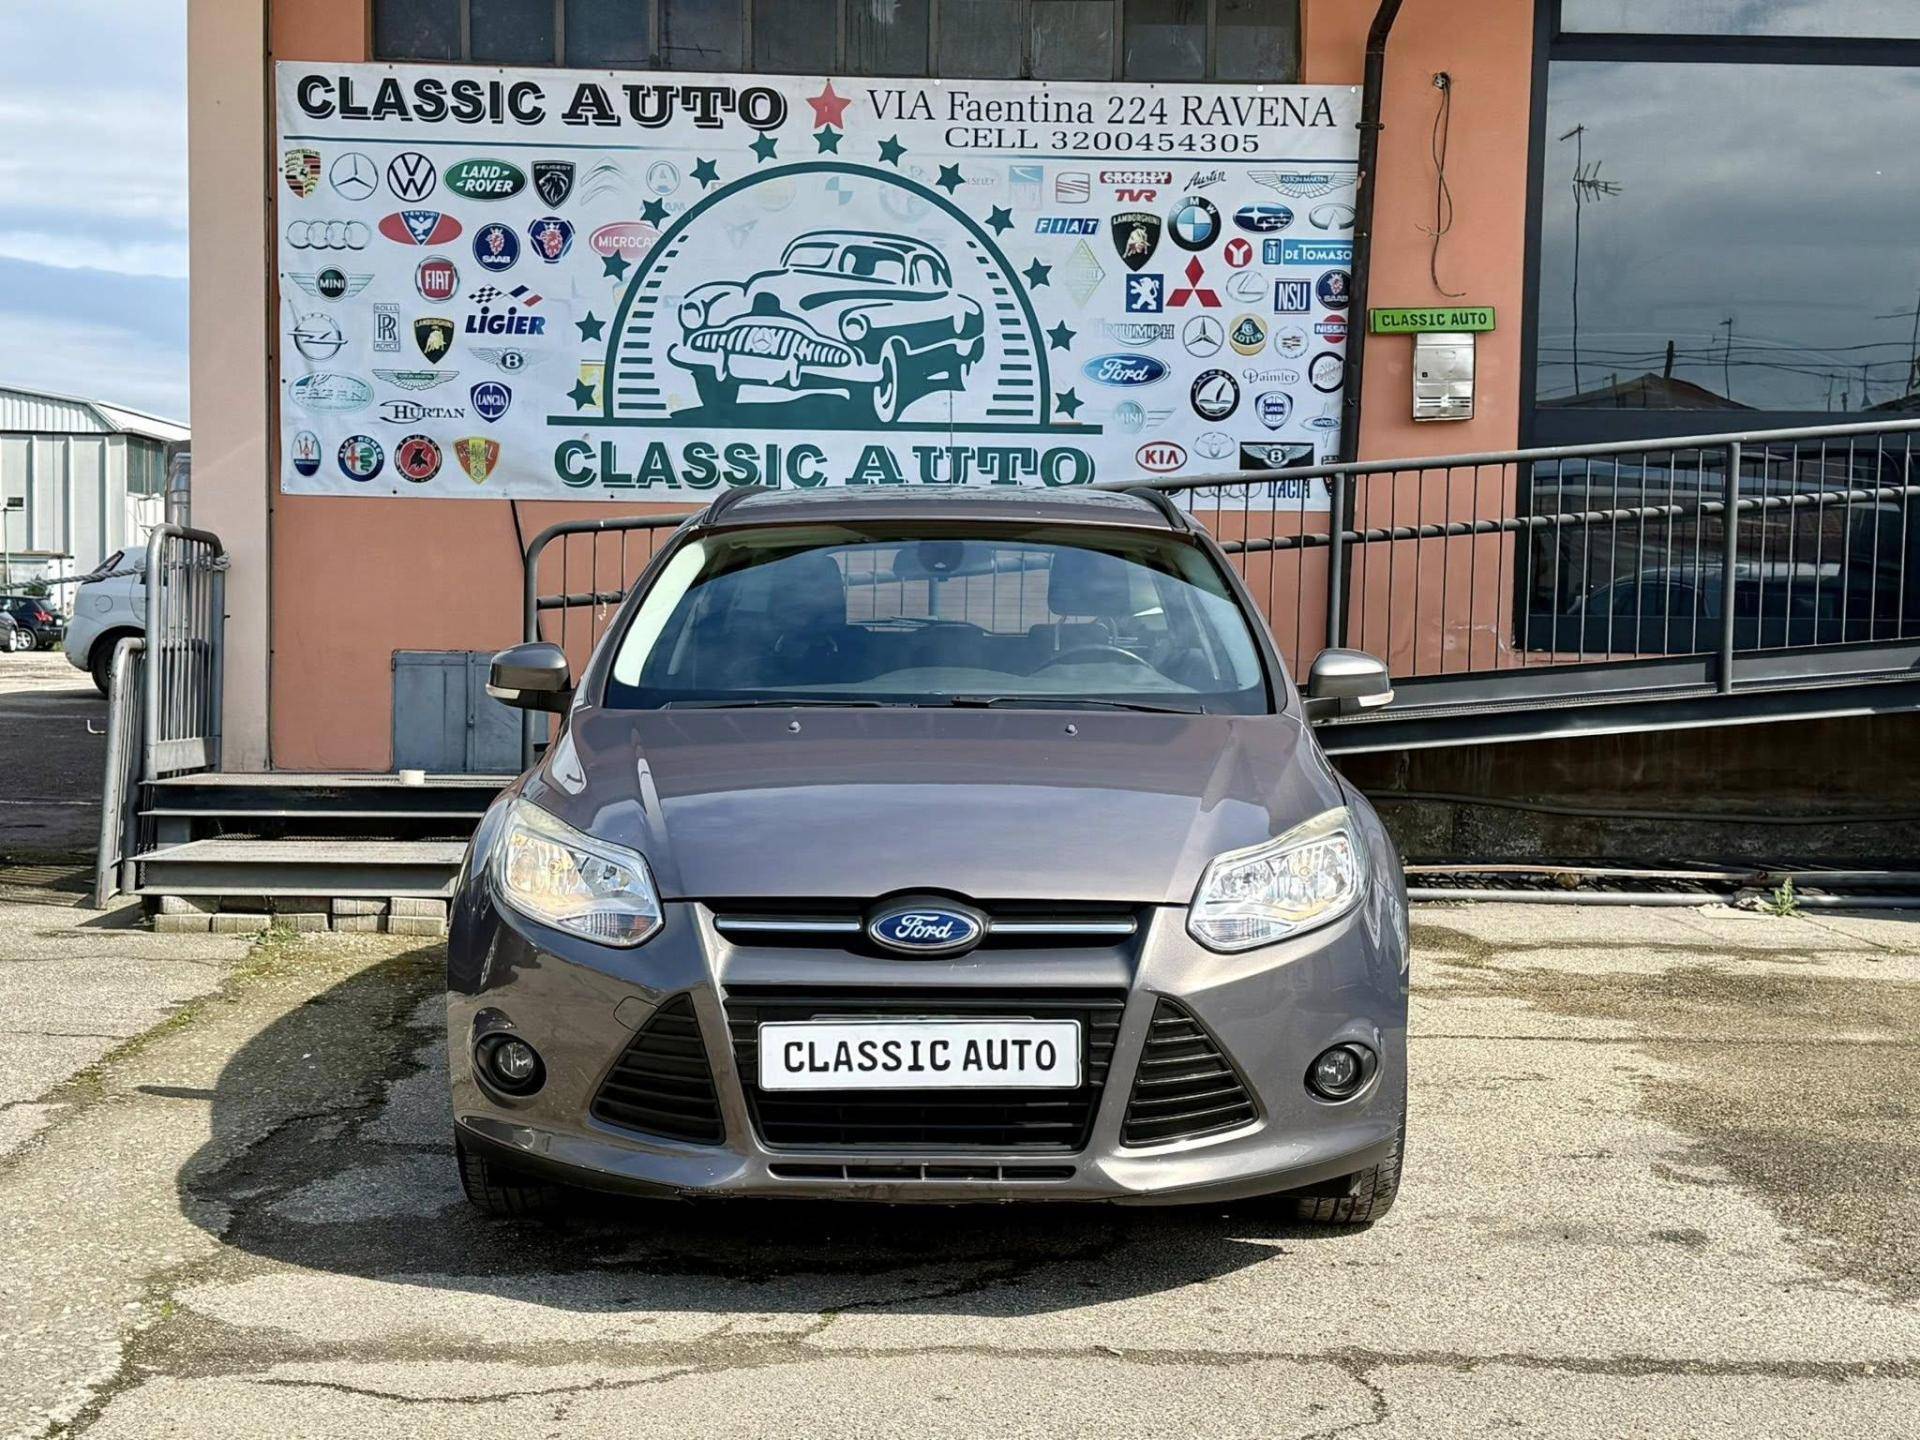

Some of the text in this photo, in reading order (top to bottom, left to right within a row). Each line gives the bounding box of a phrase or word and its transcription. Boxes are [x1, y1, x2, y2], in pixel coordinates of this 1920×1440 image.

[297, 74, 788, 131] CLASSIC AUTO
[866, 89, 1338, 127] VIA Faentina 224 RAVENA
[945, 127, 1260, 153] CELL 3200454305
[461, 165, 500, 178] LAND
[464, 179, 513, 192] ROVER
[1114, 188, 1157, 203] TVR
[1038, 218, 1098, 234] FIAT
[482, 255, 510, 263] SAAB
[1284, 244, 1352, 261] DE TOMASO
[319, 279, 344, 289] MINI
[425, 270, 451, 290] FIAT
[1278, 282, 1308, 310] NSU
[1382, 312, 1487, 326] CLASSIC AUTO
[1316, 324, 1348, 334] NISSA
[1233, 331, 1264, 344] LOTUS
[1098, 358, 1150, 381] Ford
[393, 404, 465, 419] HURTAN
[554, 439, 1096, 489] CLASSIC AUTO
[1144, 450, 1179, 464] KIA
[895, 915, 952, 939] Ford
[784, 1039, 1056, 1073] CLASSIC AUTO
